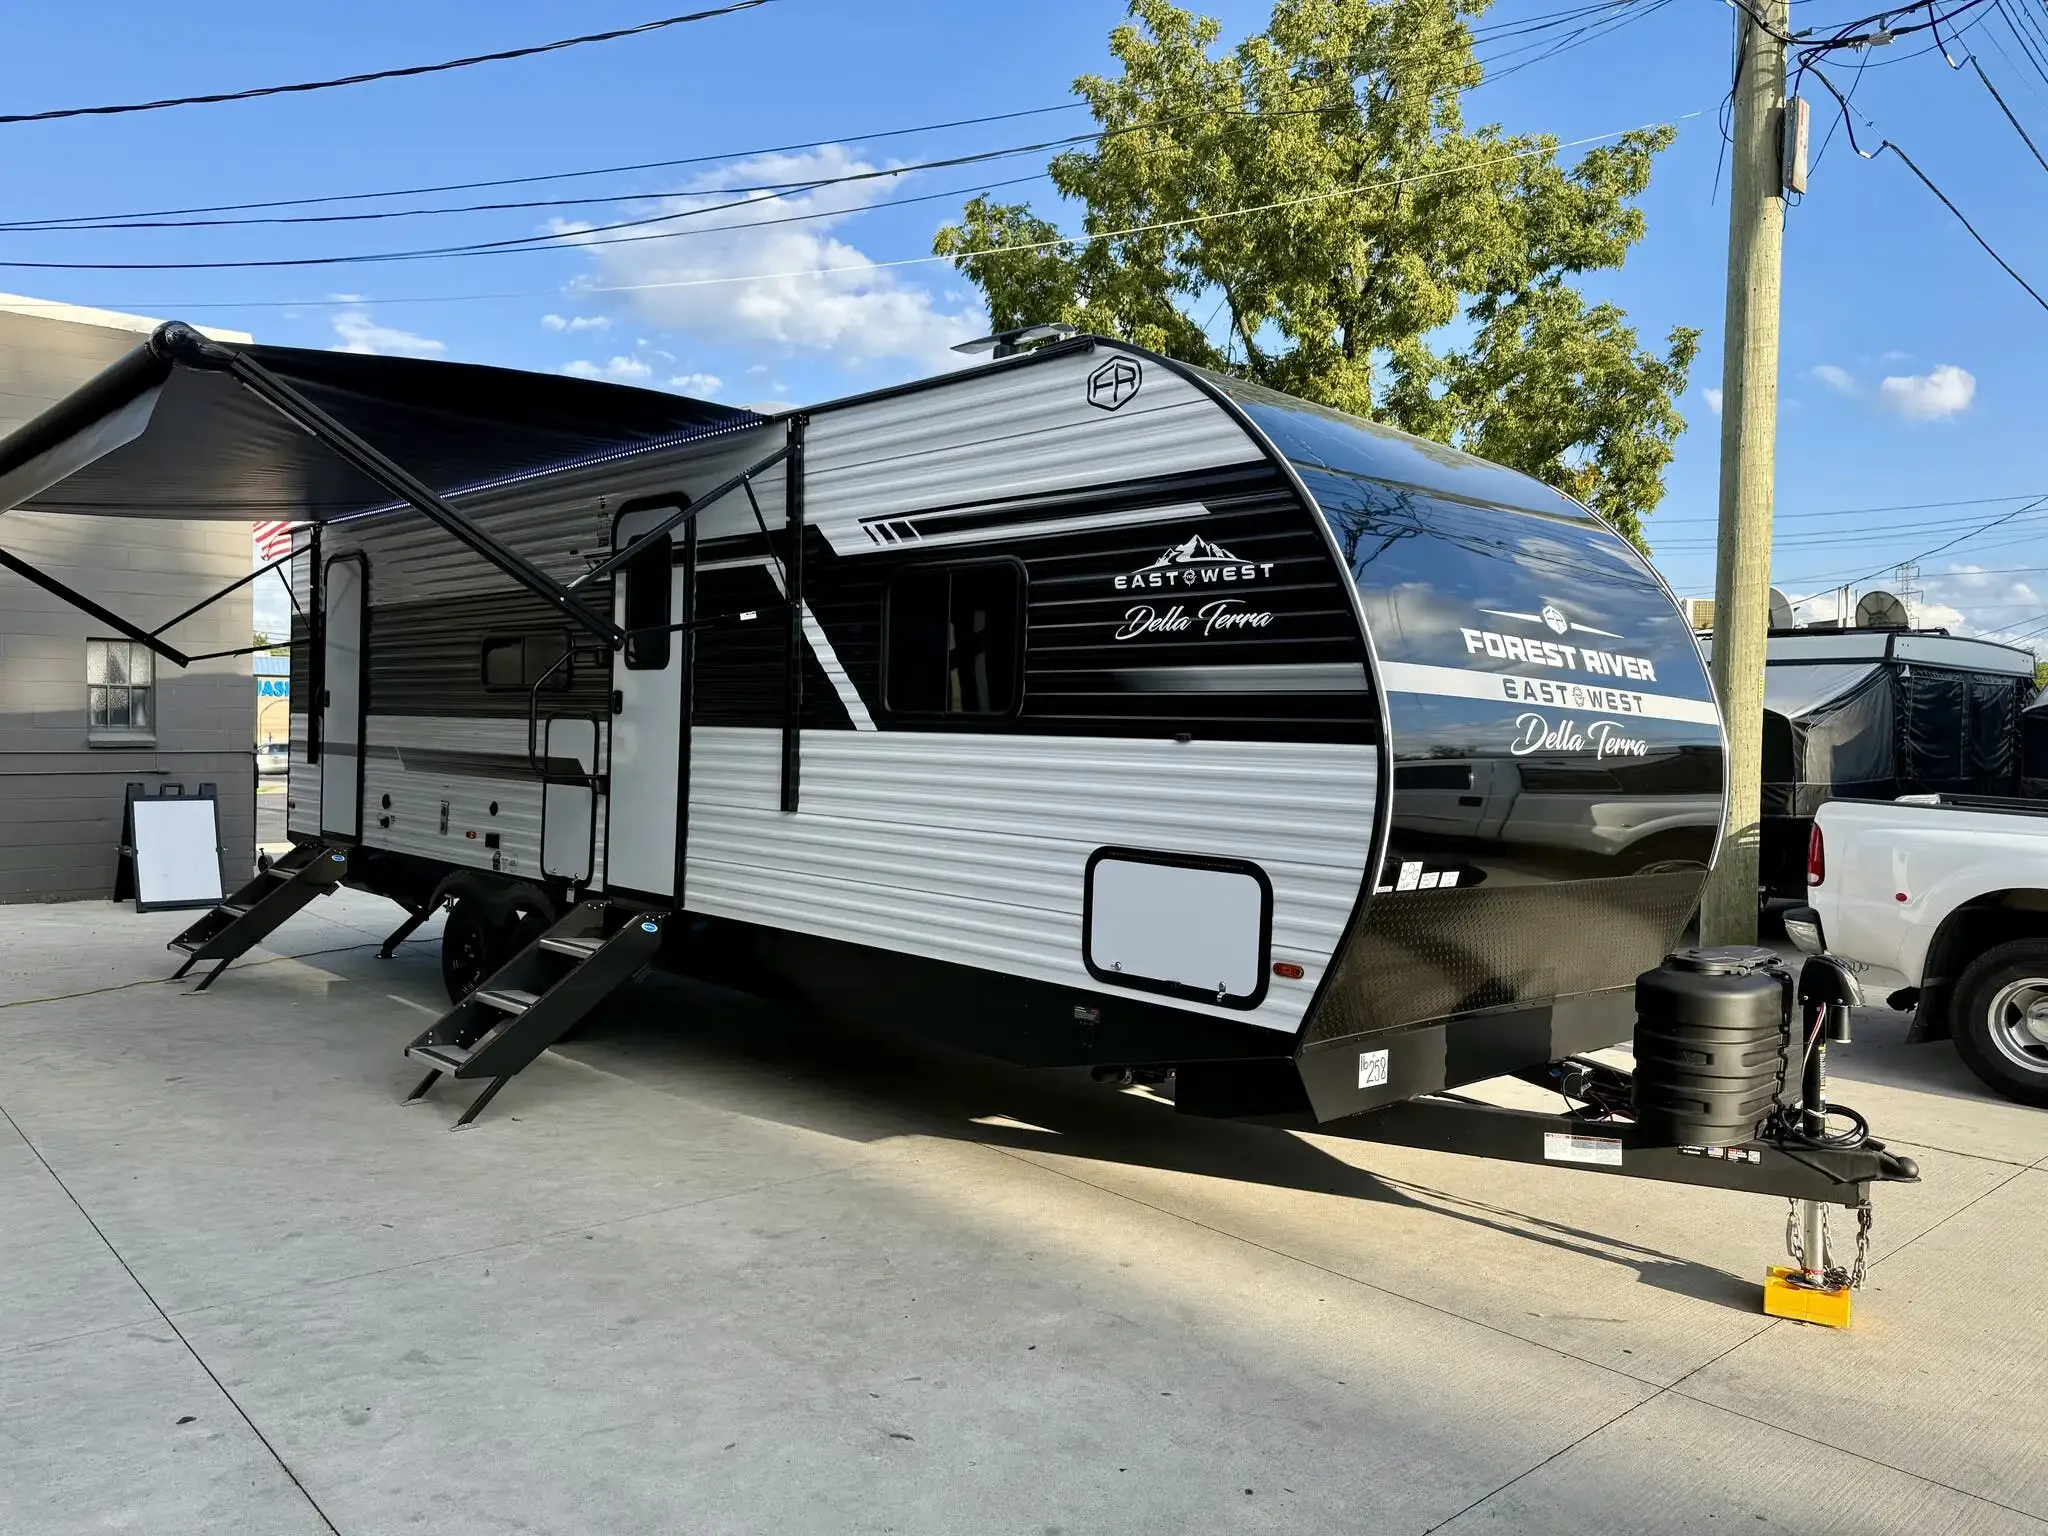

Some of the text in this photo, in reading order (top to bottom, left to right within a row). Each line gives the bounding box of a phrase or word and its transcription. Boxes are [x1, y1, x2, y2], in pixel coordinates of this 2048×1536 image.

[1114, 571, 1179, 590] EAST
[1201, 563, 1274, 583] WEST
[1114, 599, 1274, 641] Della Terra
[1459, 627, 1658, 682] FOREST RIVER
[1502, 678, 1568, 705] EAST
[1585, 690, 1643, 714] WEST
[1510, 712, 1649, 761] Della Terra
[1366, 1056, 1386, 1083] 258
